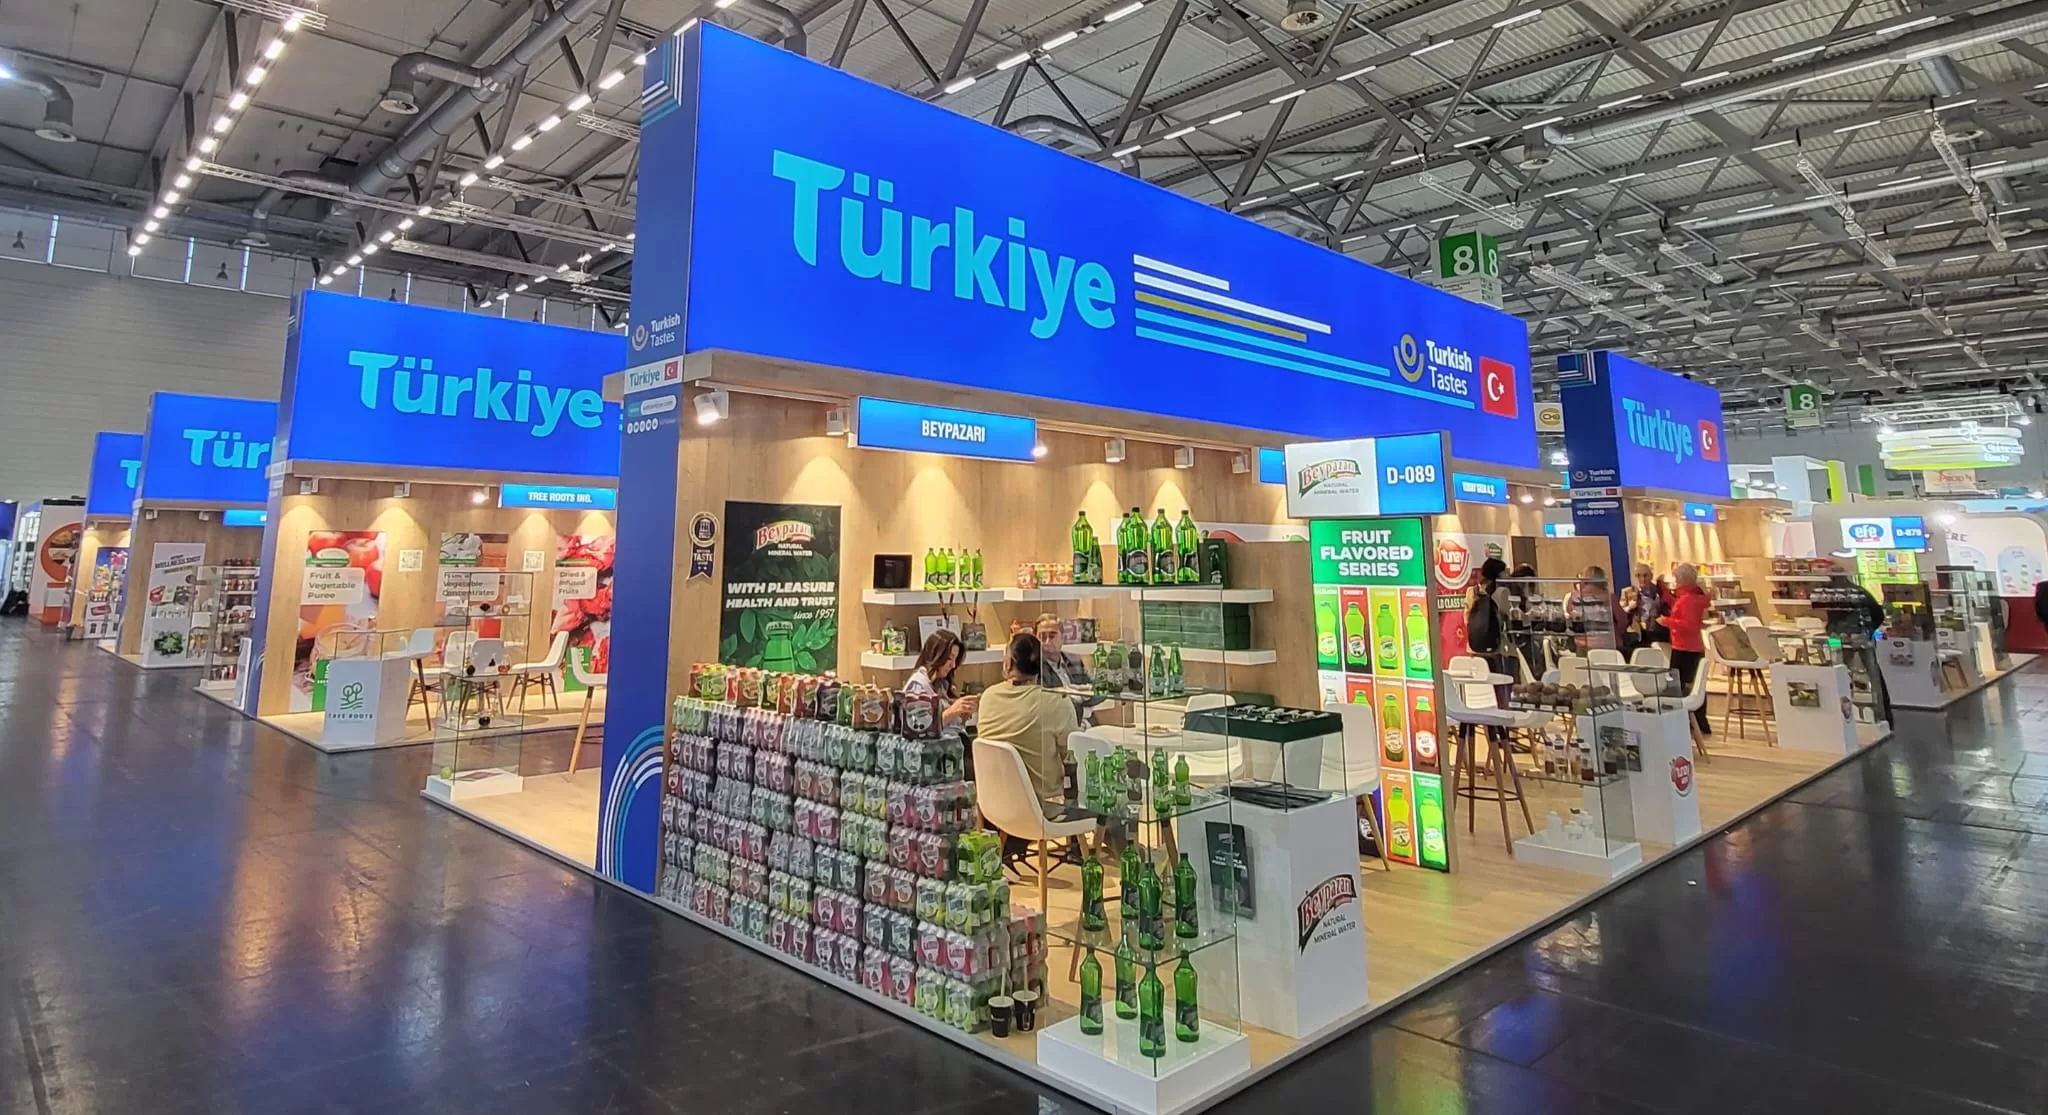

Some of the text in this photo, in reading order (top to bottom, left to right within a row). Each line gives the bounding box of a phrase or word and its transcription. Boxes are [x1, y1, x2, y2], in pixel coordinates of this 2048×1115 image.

[772, 149, 1116, 339] Türkiye
[1453, 245, 1475, 276] 8
[1488, 249, 1499, 278] 8
[650, 313, 681, 333] Turkish
[650, 331, 675, 348] Tastes
[1425, 339, 1473, 373] Turkish
[629, 369, 661, 387] Türkiye
[1427, 366, 1468, 396] Tastes
[348, 350, 604, 437] Türkiye
[1799, 393, 1815, 410] 8
[921, 419, 986, 443] BEYPAZARI
[1622, 397, 1694, 465] Türkiye
[183, 428, 276, 469] Tür
[1386, 464, 1436, 485] D-089
[528, 491, 549, 502] TREE
[549, 492, 575, 502] ROOTS
[1341, 530, 1392, 544] FRUIT
[1854, 525, 1878, 538] efe
[693, 552, 713, 562] TASTE
[1319, 545, 1414, 561] FLAVORED
[309, 572, 342, 580] Fruit &
[1338, 562, 1400, 577] SERIES
[308, 582, 357, 591] Vegetable
[727, 581, 836, 594] WITH PLEASURE
[307, 592, 336, 600] Puree
[725, 596, 836, 609] HEALTH AND TRUST
[1445, 597, 1461, 609] CLASS
[793, 608, 835, 620] since 1957
[1323, 913, 1347, 929] NATURAL
[1313, 921, 1356, 944] MINERAL WATER
